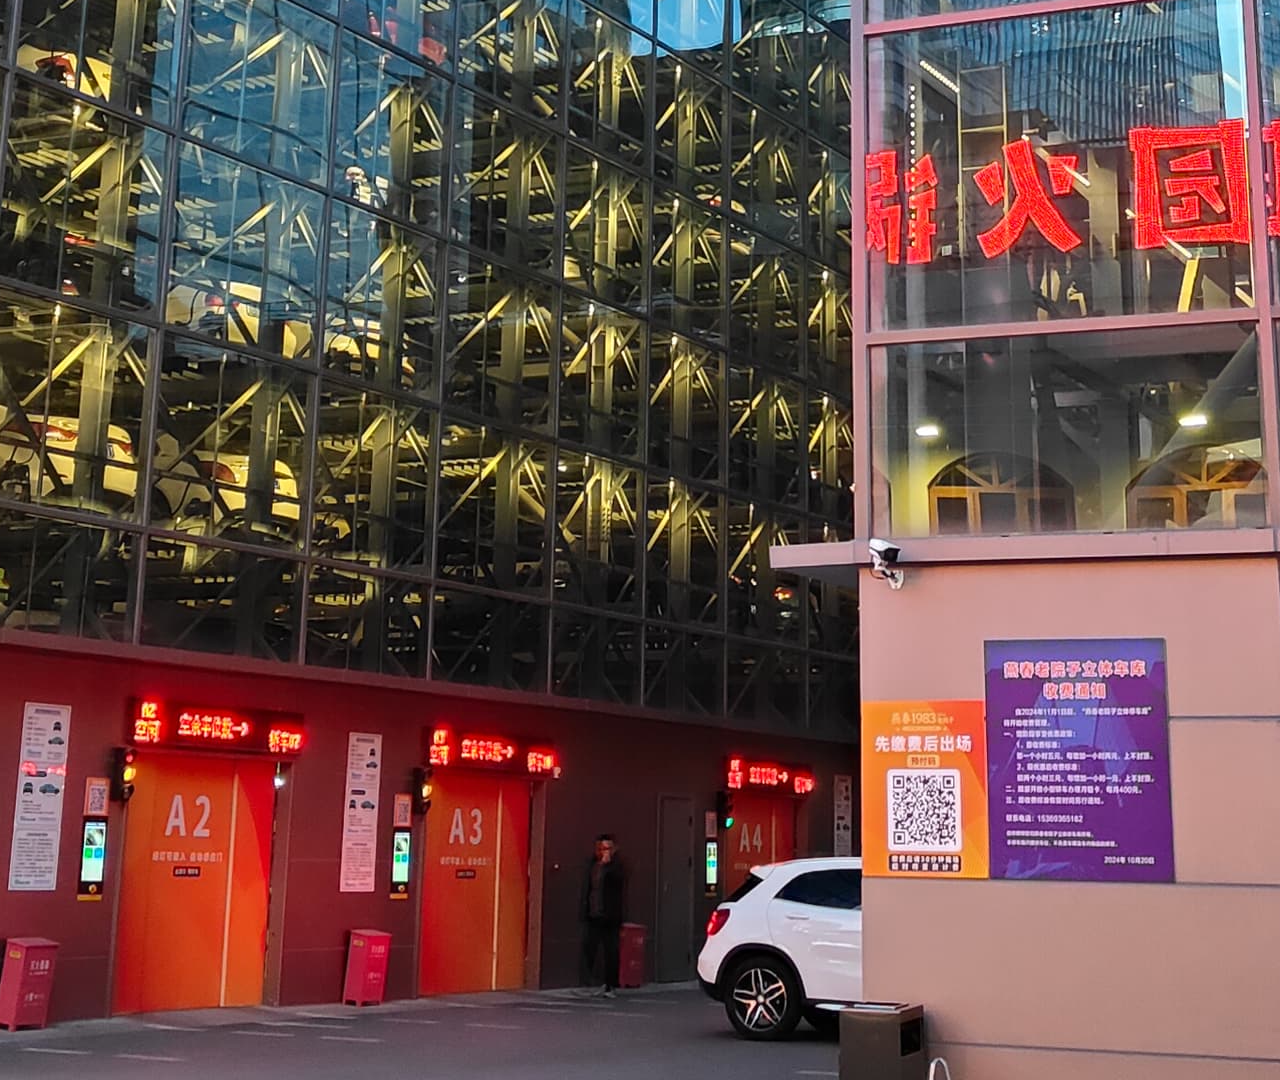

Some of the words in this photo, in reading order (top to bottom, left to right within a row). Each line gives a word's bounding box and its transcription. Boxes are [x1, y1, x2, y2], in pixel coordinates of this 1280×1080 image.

[1004, 660, 1147, 679] 燕春老院子立体车库
[1043, 682, 1107, 700] 收费通知
[874, 735, 973, 753] 先缴费后出场
[164, 794, 211, 837] A2
[448, 807, 483, 845] A3
[739, 823, 763, 853] A4
